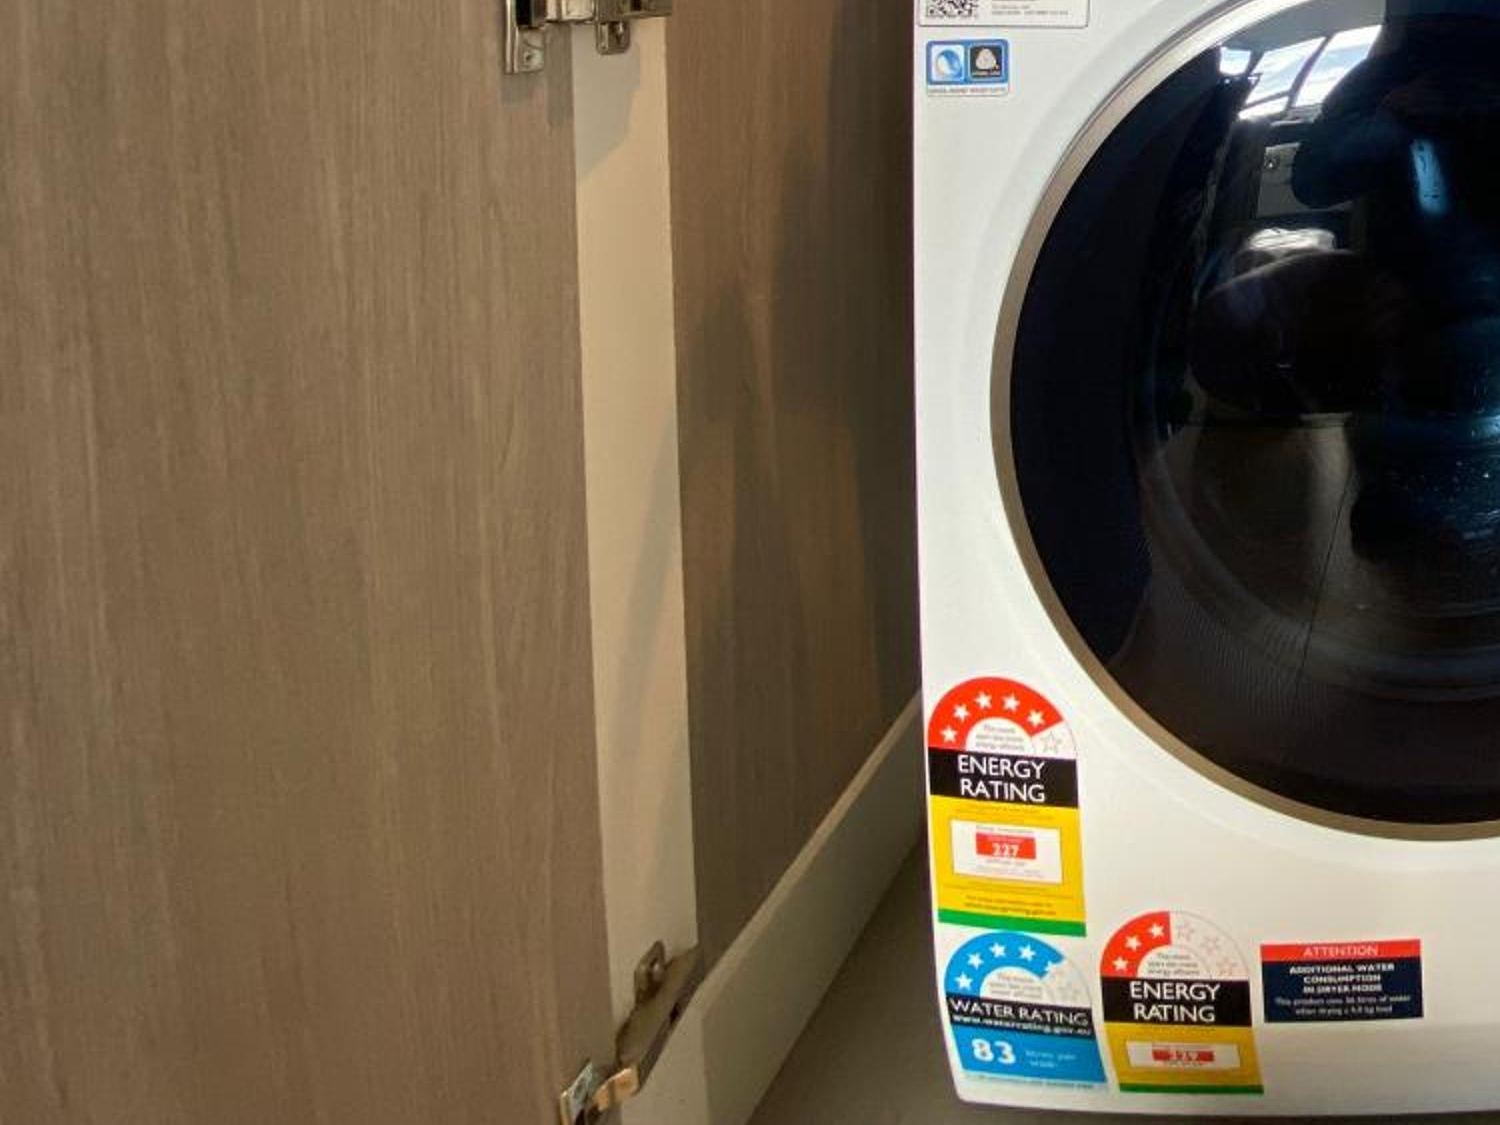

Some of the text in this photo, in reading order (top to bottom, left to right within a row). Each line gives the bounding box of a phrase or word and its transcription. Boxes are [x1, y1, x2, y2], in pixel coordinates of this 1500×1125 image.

[957, 754, 1045, 779] ENERGY
[960, 778, 1046, 803] RATING
[1302, 944, 1379, 958] ATTENTION
[1289, 962, 1395, 975] ADDITIONAL WATER
[1303, 973, 1381, 985] CONSUMPTION
[1129, 980, 1221, 1001] ENERGY
[1316, 984, 1350, 994] DRYER
[1351, 983, 1383, 993] MODE
[949, 998, 1089, 1026] WATER RATING
[1133, 1002, 1216, 1023] RATING
[971, 1037, 1017, 1065] 83
